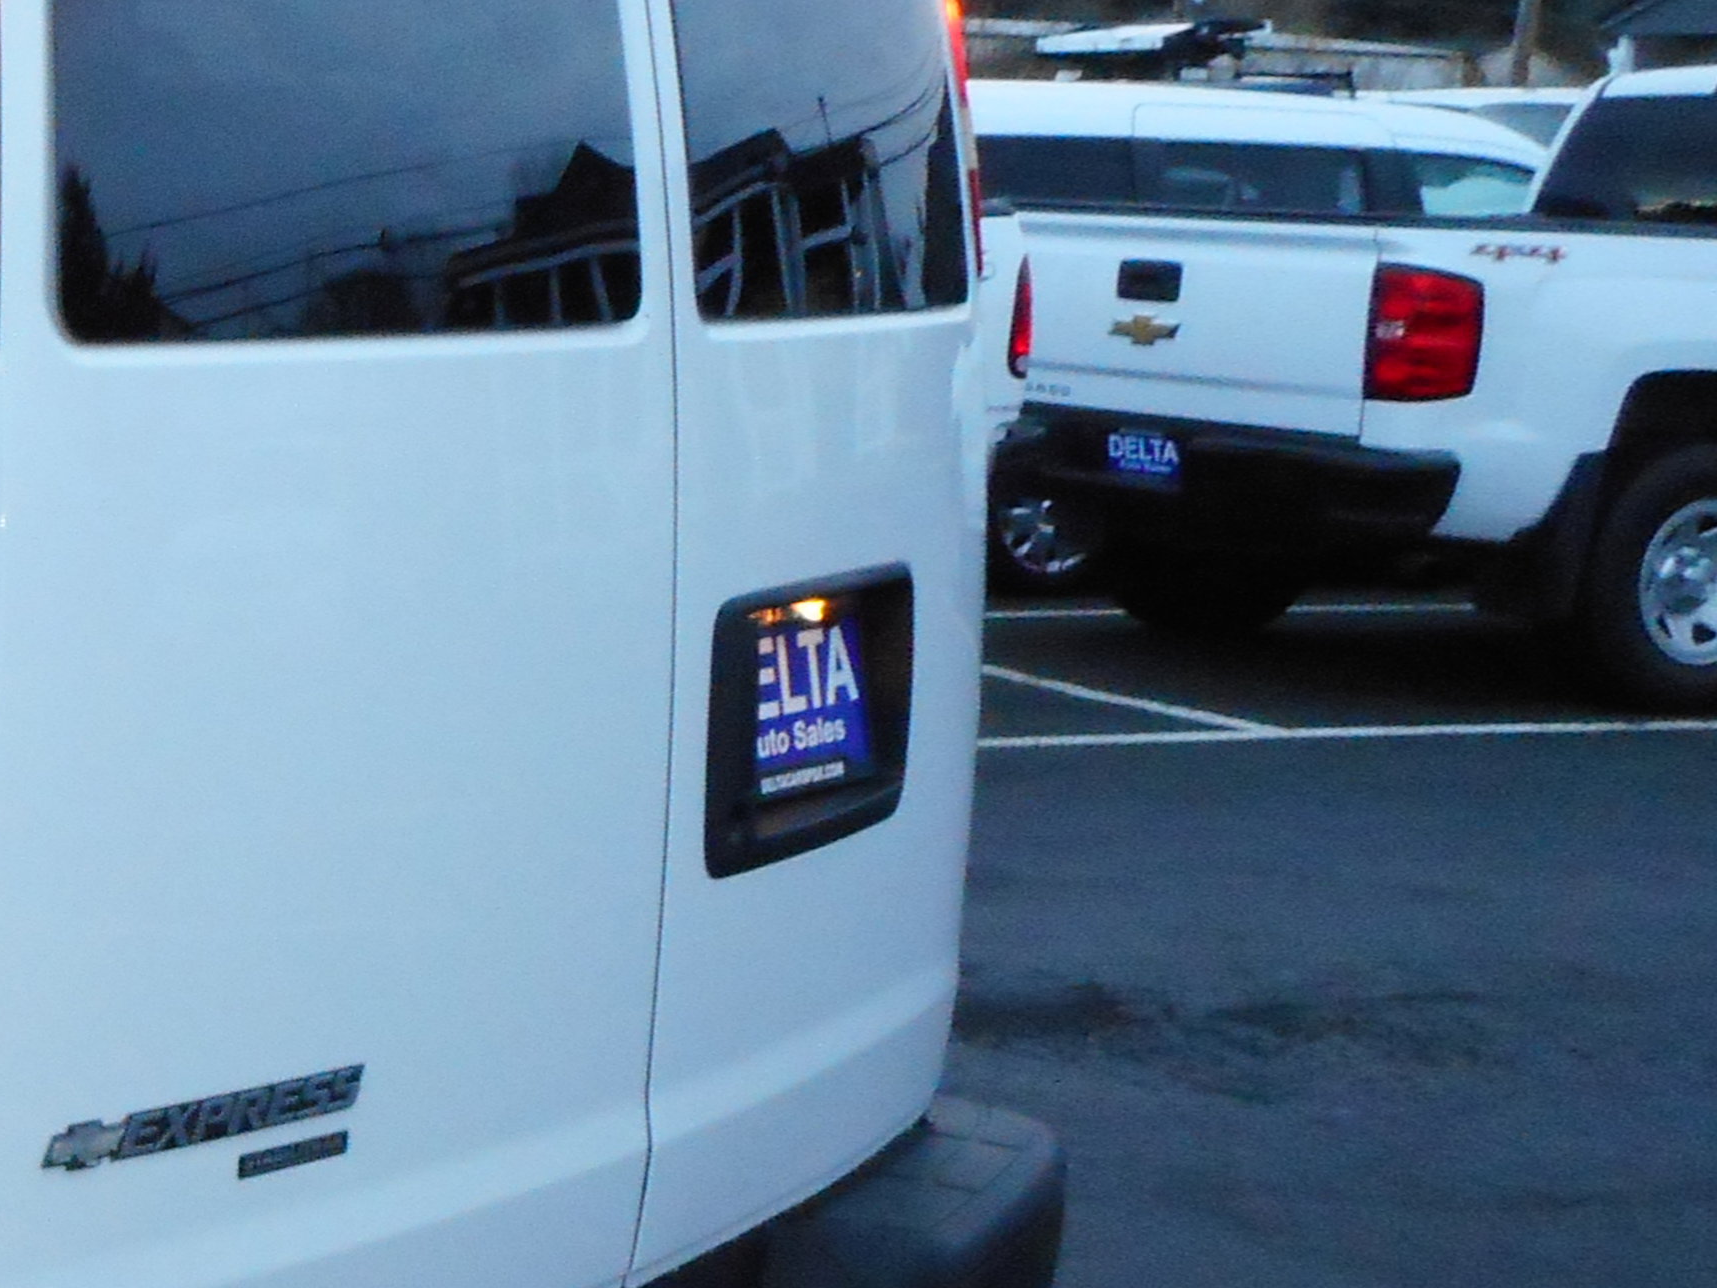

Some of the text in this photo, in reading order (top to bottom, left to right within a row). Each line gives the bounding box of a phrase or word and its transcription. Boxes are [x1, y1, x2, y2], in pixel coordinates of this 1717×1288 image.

[1108, 434, 1180, 465] DELTA
[758, 625, 859, 720] ELTA
[756, 717, 846, 758] uto Sales
[115, 1064, 364, 1160] EXPRESS
